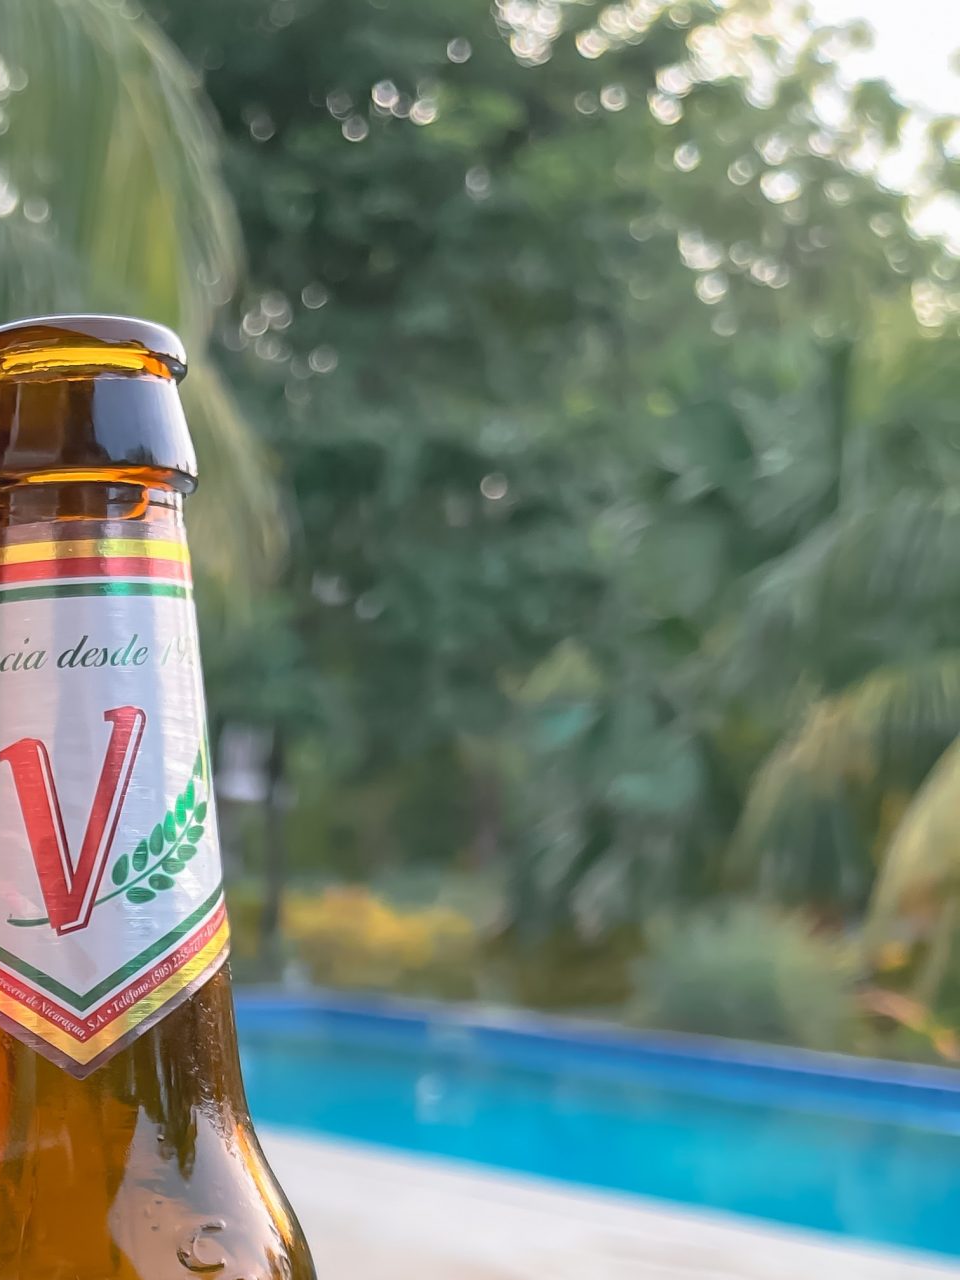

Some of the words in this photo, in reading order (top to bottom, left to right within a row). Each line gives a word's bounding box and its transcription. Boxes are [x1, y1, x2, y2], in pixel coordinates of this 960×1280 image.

[56, 633, 149, 668] desde
[25, 994, 38, 1007] de
[38, 1001, 87, 1040] Nicaragua,
[151, 962, 173, 985] (505)
